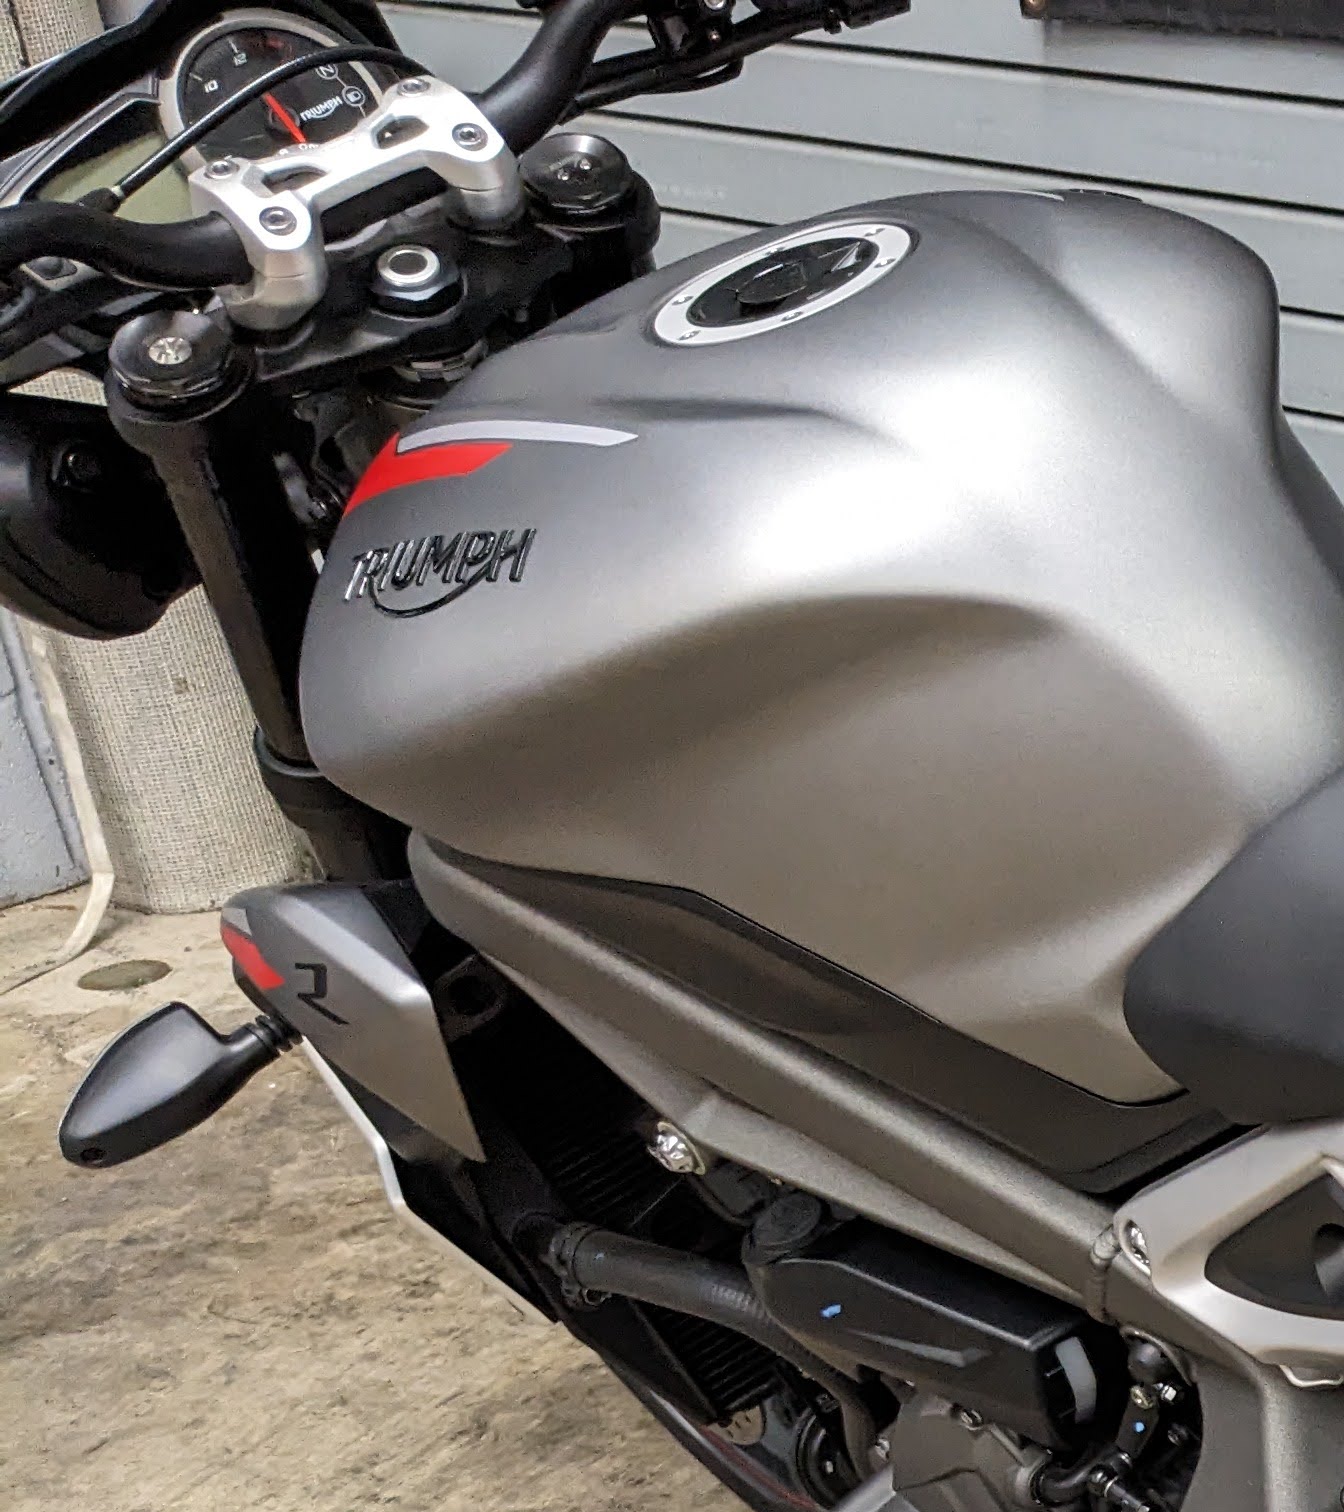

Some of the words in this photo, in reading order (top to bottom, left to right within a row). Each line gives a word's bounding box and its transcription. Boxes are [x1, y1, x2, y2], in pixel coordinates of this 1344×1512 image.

[204, 79, 219, 94] 10
[299, 95, 343, 121] TRIUMPH
[343, 527, 538, 618] TRIUMPH
